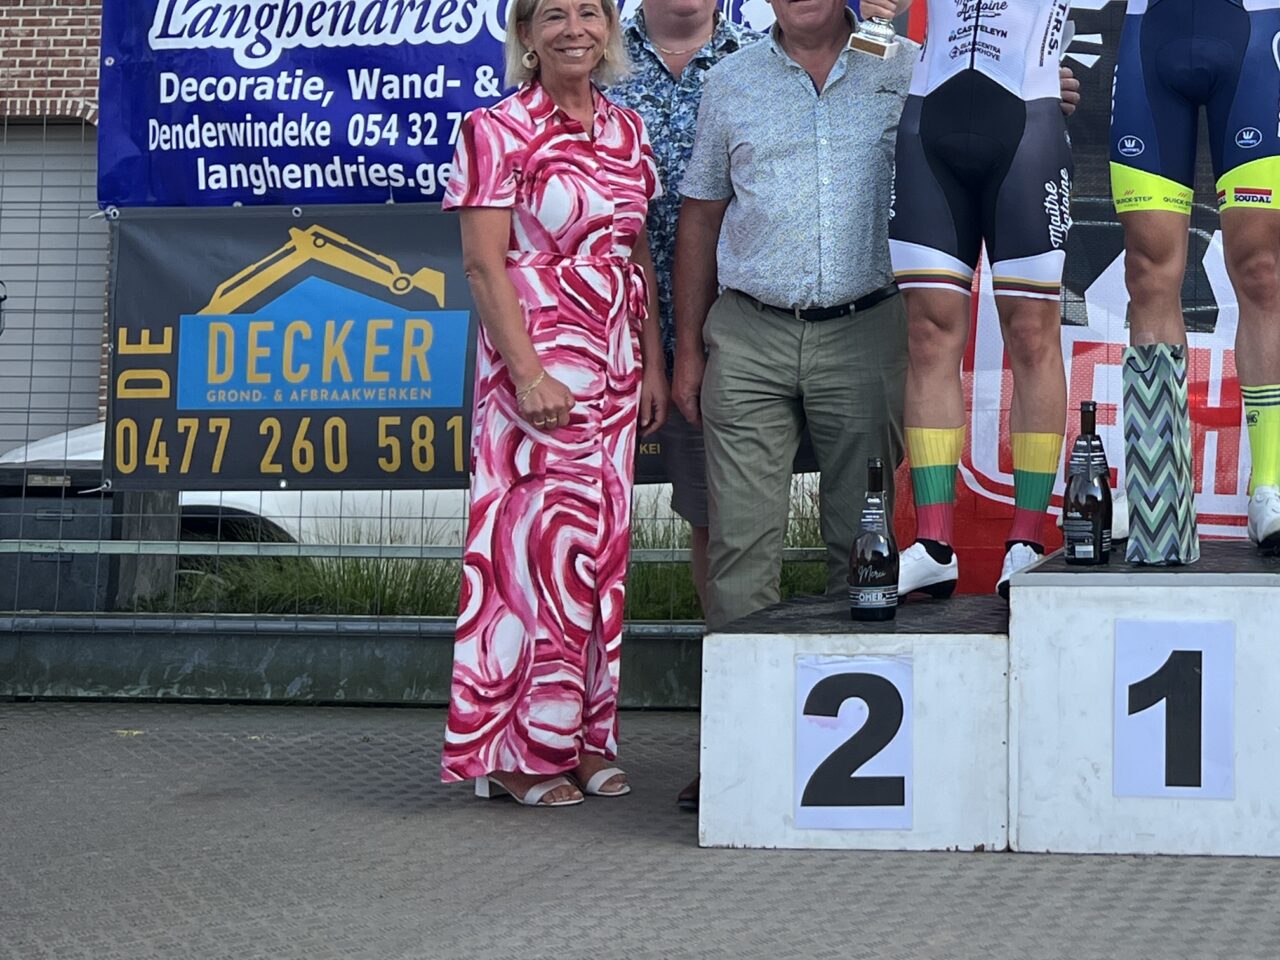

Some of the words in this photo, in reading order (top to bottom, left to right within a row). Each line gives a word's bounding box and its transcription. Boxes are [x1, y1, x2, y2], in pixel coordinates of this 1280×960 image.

[957, 0, 1009, 17] Anoine
[1047, 3, 1068, 55] T.R.S.
[159, 69, 335, 107] Decoratie,
[347, 65, 461, 101] Wand-
[474, 64, 502, 98] &
[149, 113, 331, 151] Denderwindeke
[347, 112, 400, 147] 054
[407, 112, 439, 146] 32
[197, 155, 453, 194] langhendries.ge
[1234, 194, 1272, 204] SOUDAL
[1043, 180, 1064, 248] Maître
[117, 326, 173, 399] DE
[207, 319, 433, 384] DECKER
[207, 389, 267, 403] GROND-
[274, 388, 283, 402] &
[290, 387, 432, 402] AFBRAAKWERKEN
[115, 417, 231, 474] 0477
[259, 415, 349, 473] 260
[377, 414, 464, 473] 581
[800, 672, 906, 808] 2
[1127, 649, 1203, 787] 1
